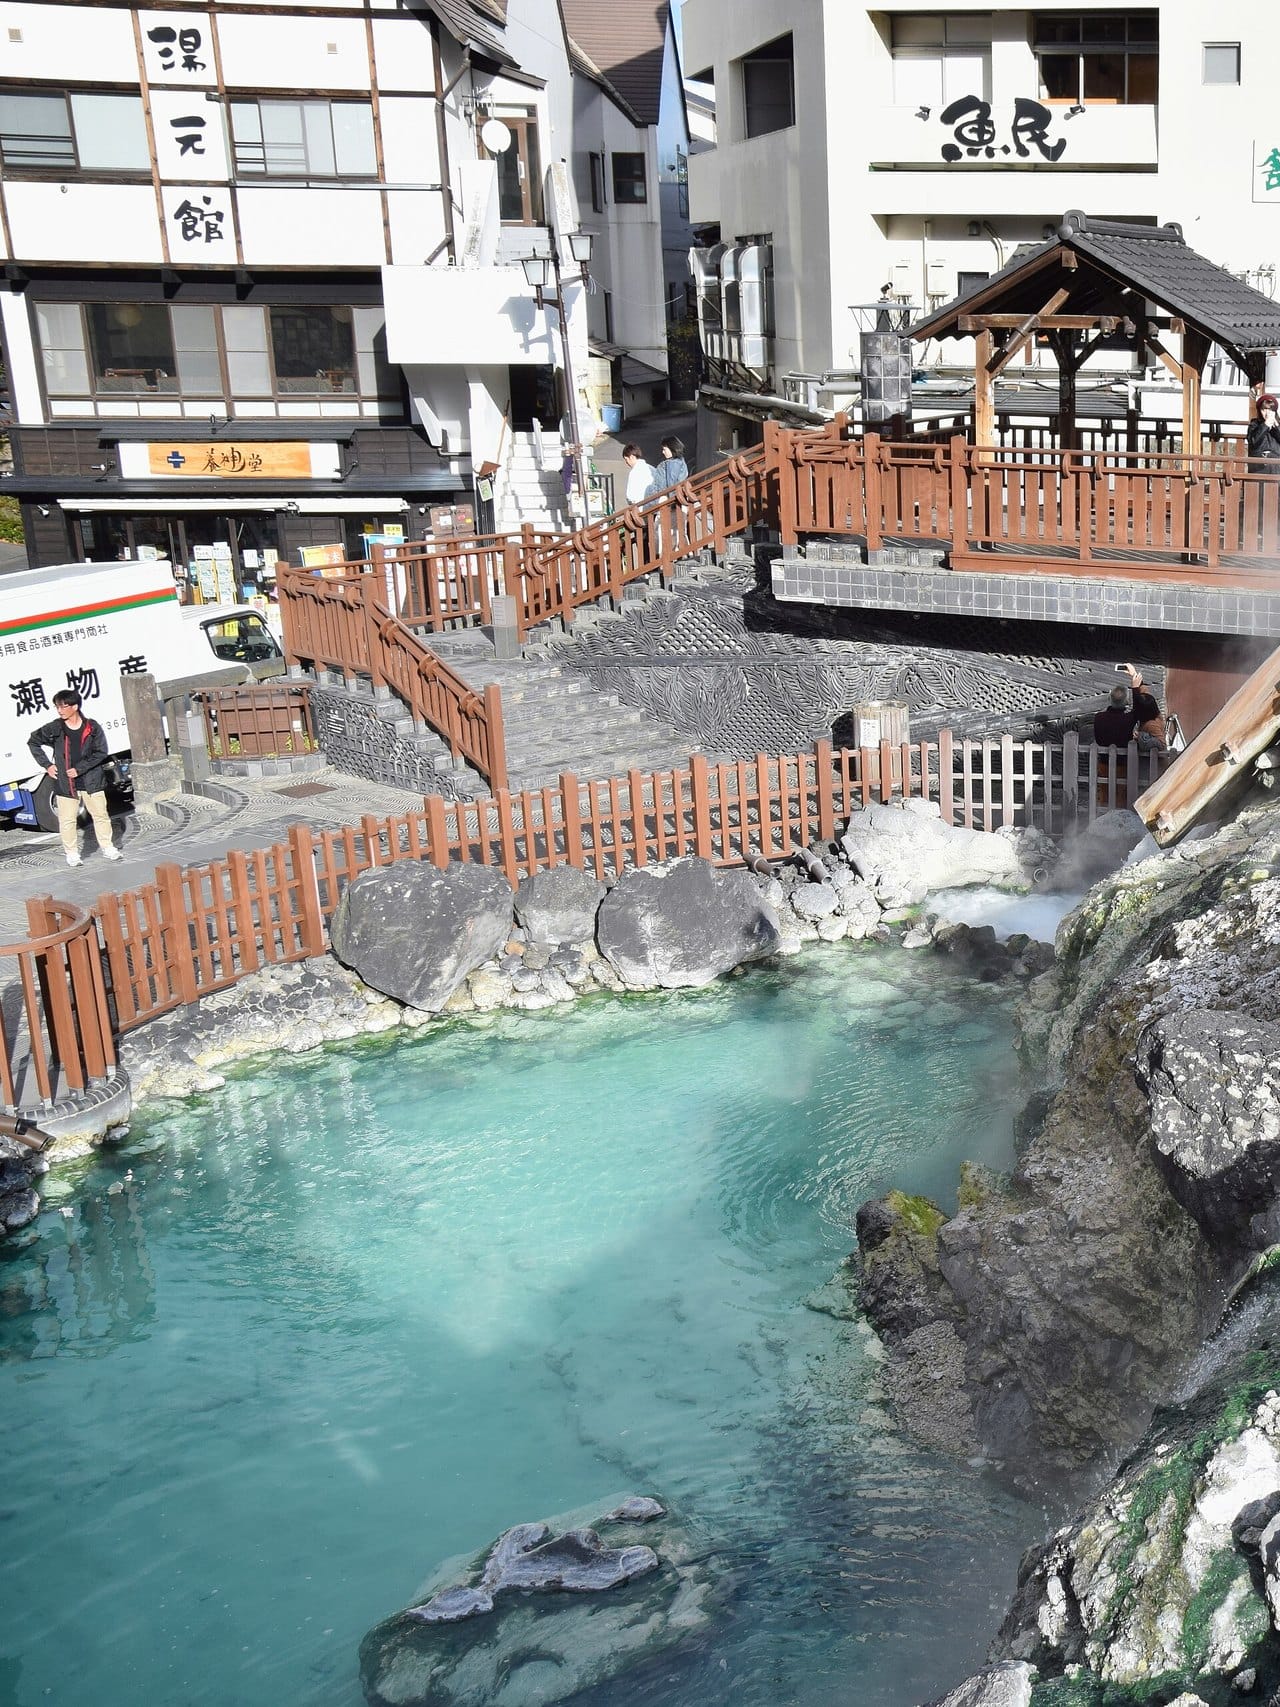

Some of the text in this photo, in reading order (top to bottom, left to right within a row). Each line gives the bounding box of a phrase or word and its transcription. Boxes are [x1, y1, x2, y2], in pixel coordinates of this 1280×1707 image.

[147, 26, 224, 244] 湯元館
[940, 94, 1067, 162] 魚民
[0, 623, 109, 658] 用食品酒類専門商社
